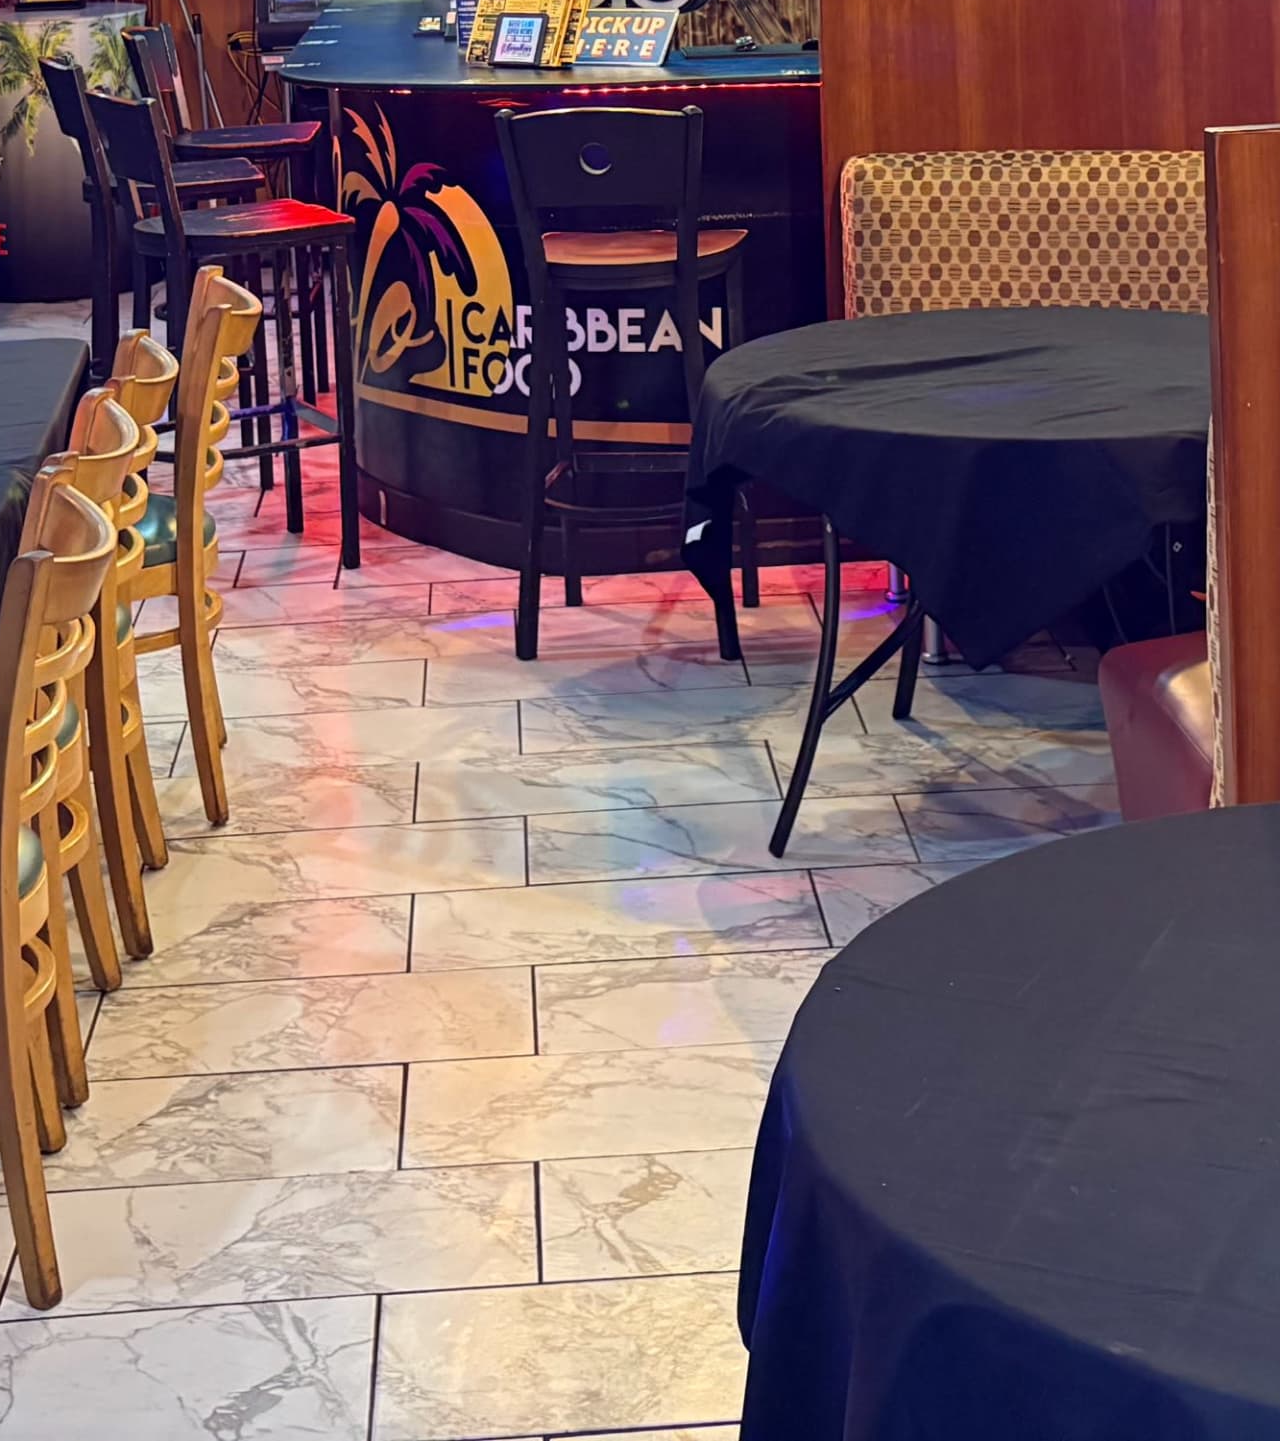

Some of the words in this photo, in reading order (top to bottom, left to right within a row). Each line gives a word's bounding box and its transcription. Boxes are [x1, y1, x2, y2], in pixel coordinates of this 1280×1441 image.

[582, 15, 631, 35] PICK
[632, 15, 667, 36] UP
[461, 301, 722, 353] CARBBEAN
